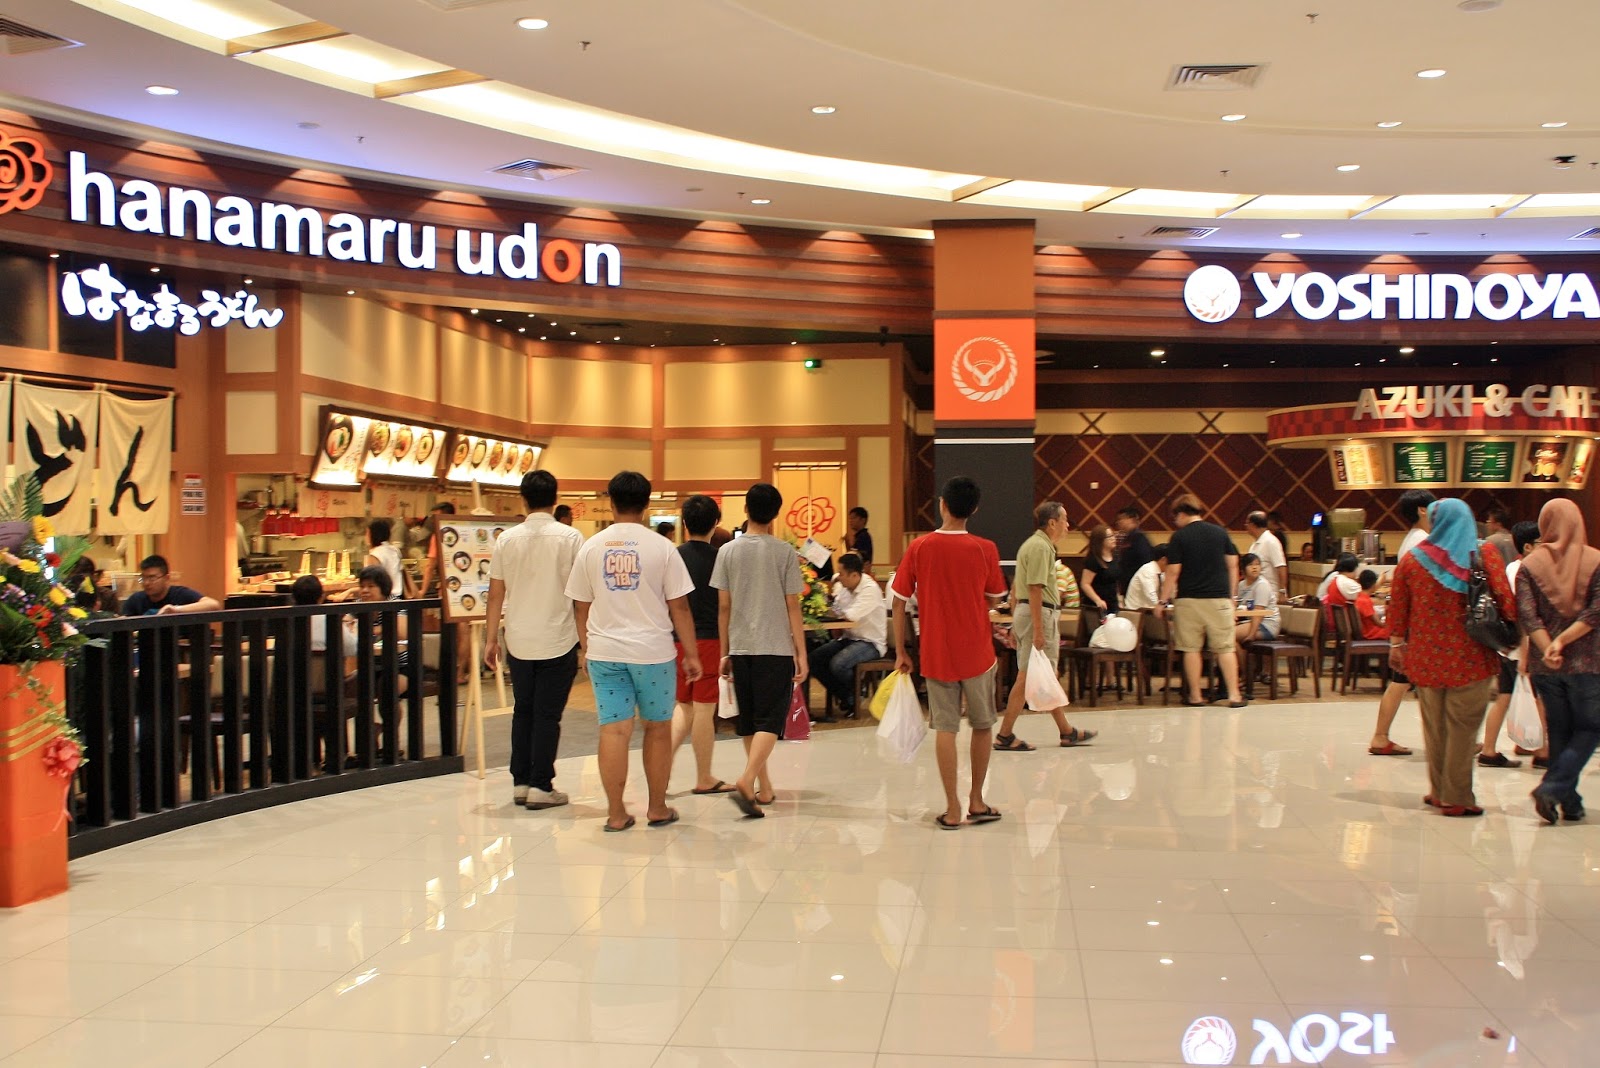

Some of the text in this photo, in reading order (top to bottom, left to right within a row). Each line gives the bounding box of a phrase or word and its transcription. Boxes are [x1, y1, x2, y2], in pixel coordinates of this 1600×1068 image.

[69, 150, 622, 287] hanamaru udon
[61, 262, 284, 336] はなまるうどん
[1253, 271, 1600, 321] YOSHINOYA
[1352, 383, 1599, 421] AZUKI & CAFE
[606, 554, 640, 574] COOL
